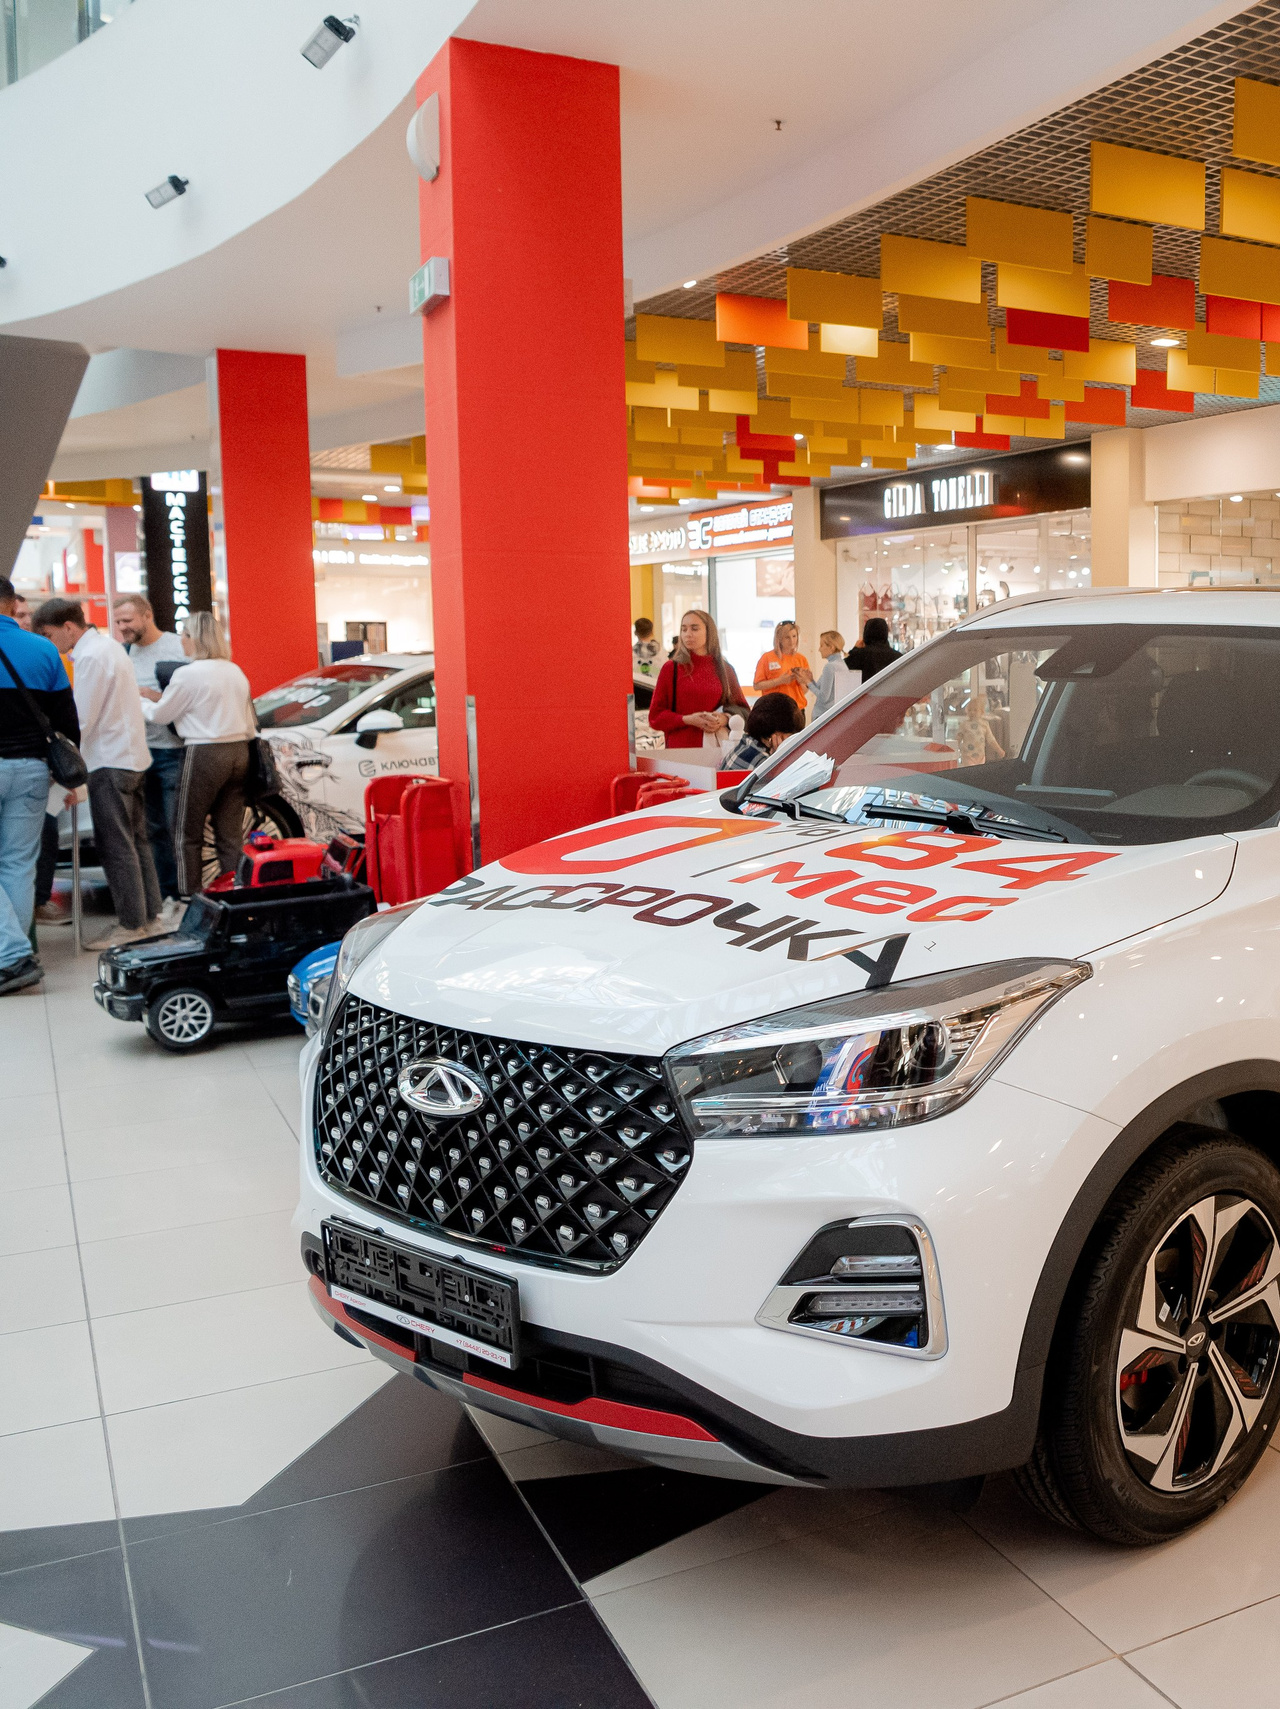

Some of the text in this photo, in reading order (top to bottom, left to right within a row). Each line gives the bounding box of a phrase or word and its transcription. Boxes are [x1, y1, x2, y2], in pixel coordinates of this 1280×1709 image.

[883, 471, 993, 519] GILDA TONELLI
[824, 831, 1122, 889] 84
[410, 1320, 435, 1334] CHERY
